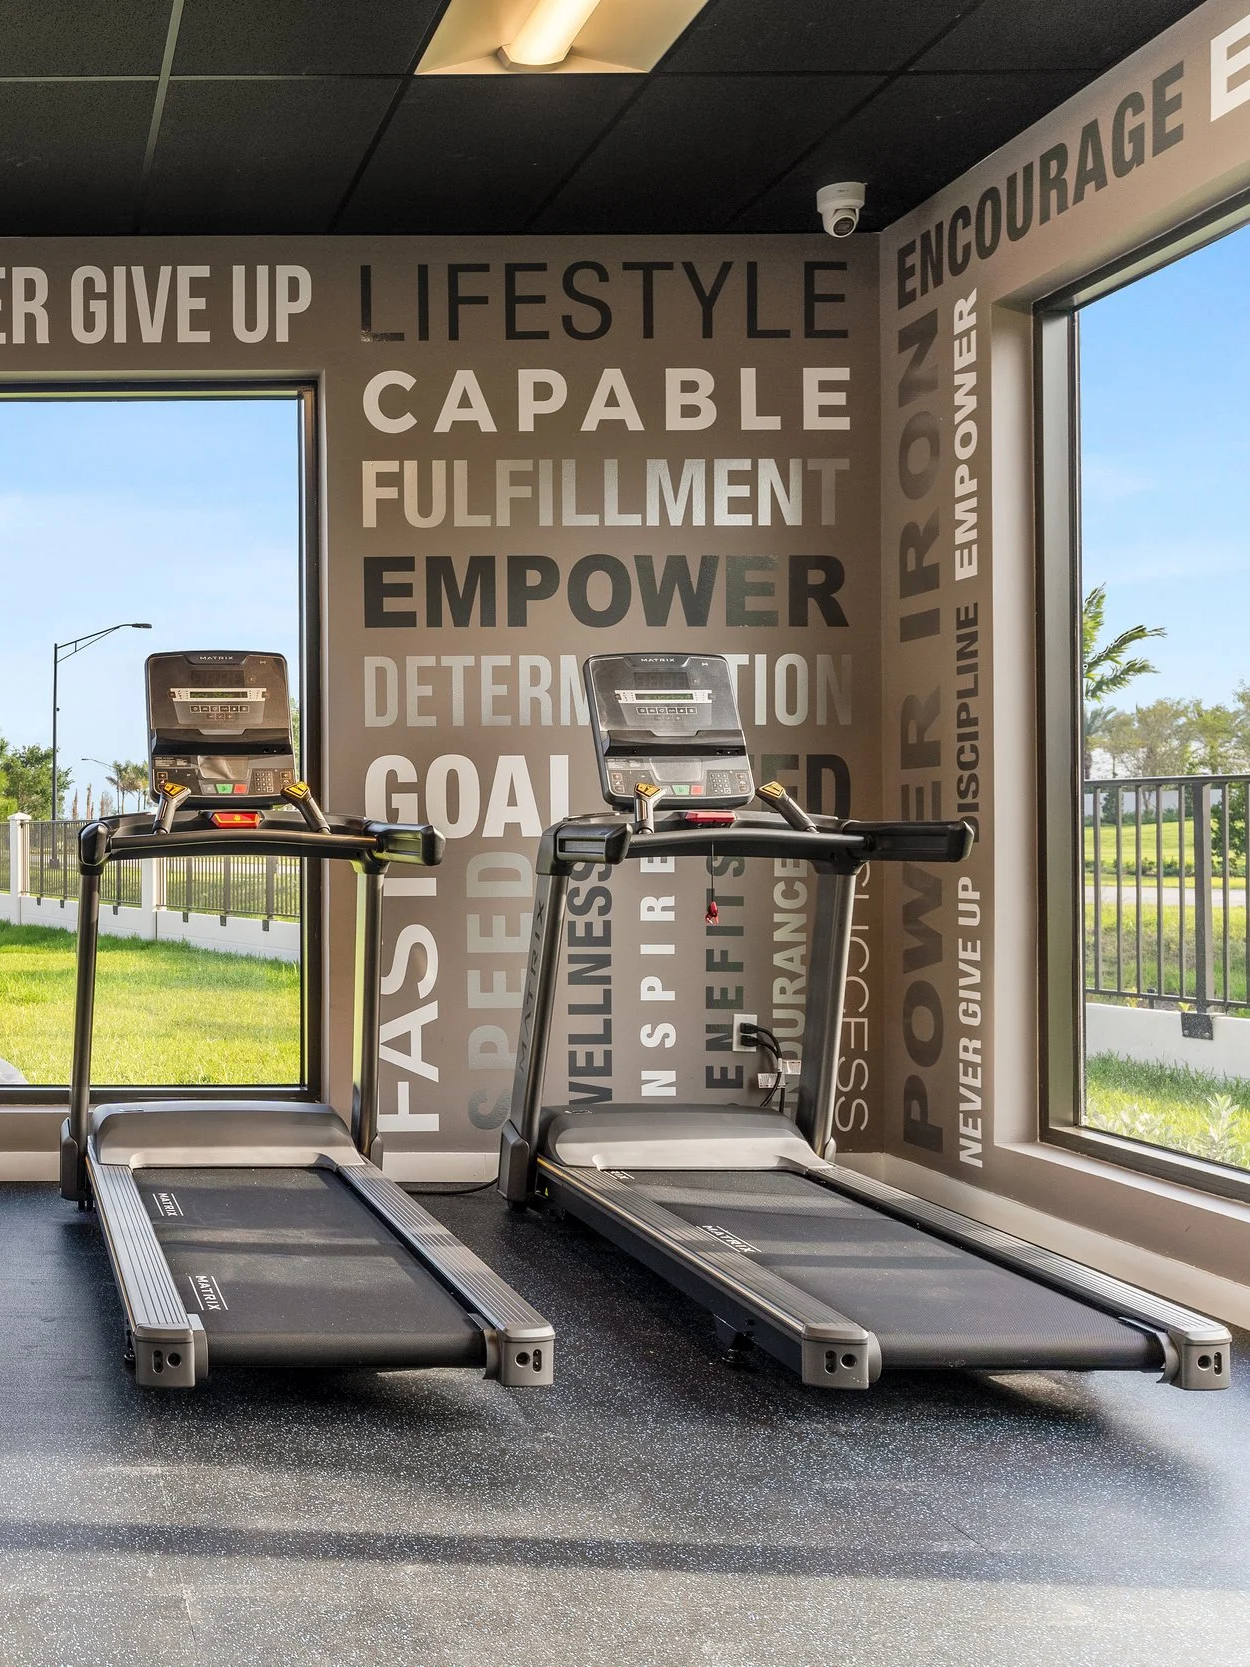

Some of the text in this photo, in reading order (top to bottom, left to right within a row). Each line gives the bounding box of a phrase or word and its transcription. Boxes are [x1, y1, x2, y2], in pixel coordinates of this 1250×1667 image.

[897, 60, 1184, 310] ENCOURAGE
[70, 265, 211, 344] GIVE
[232, 264, 312, 343] UP
[359, 260, 849, 342] LIFESTYLE
[362, 367, 851, 434] CAPABLE
[953, 287, 979, 582] EMPOWER
[361, 458, 850, 529] FULFILLMENT
[363, 554, 850, 629] EMPOWER
[363, 652, 852, 729] DETERMTION
[897, 307, 944, 1154] POWER IRON
[465, 851, 534, 1131] SPEED
[957, 876, 984, 1168] NEVER GIVE UP
[157, 1192, 179, 1217] MATRIX
[701, 1224, 756, 1253] MATRIX
[195, 1275, 222, 1311] MATRIX
